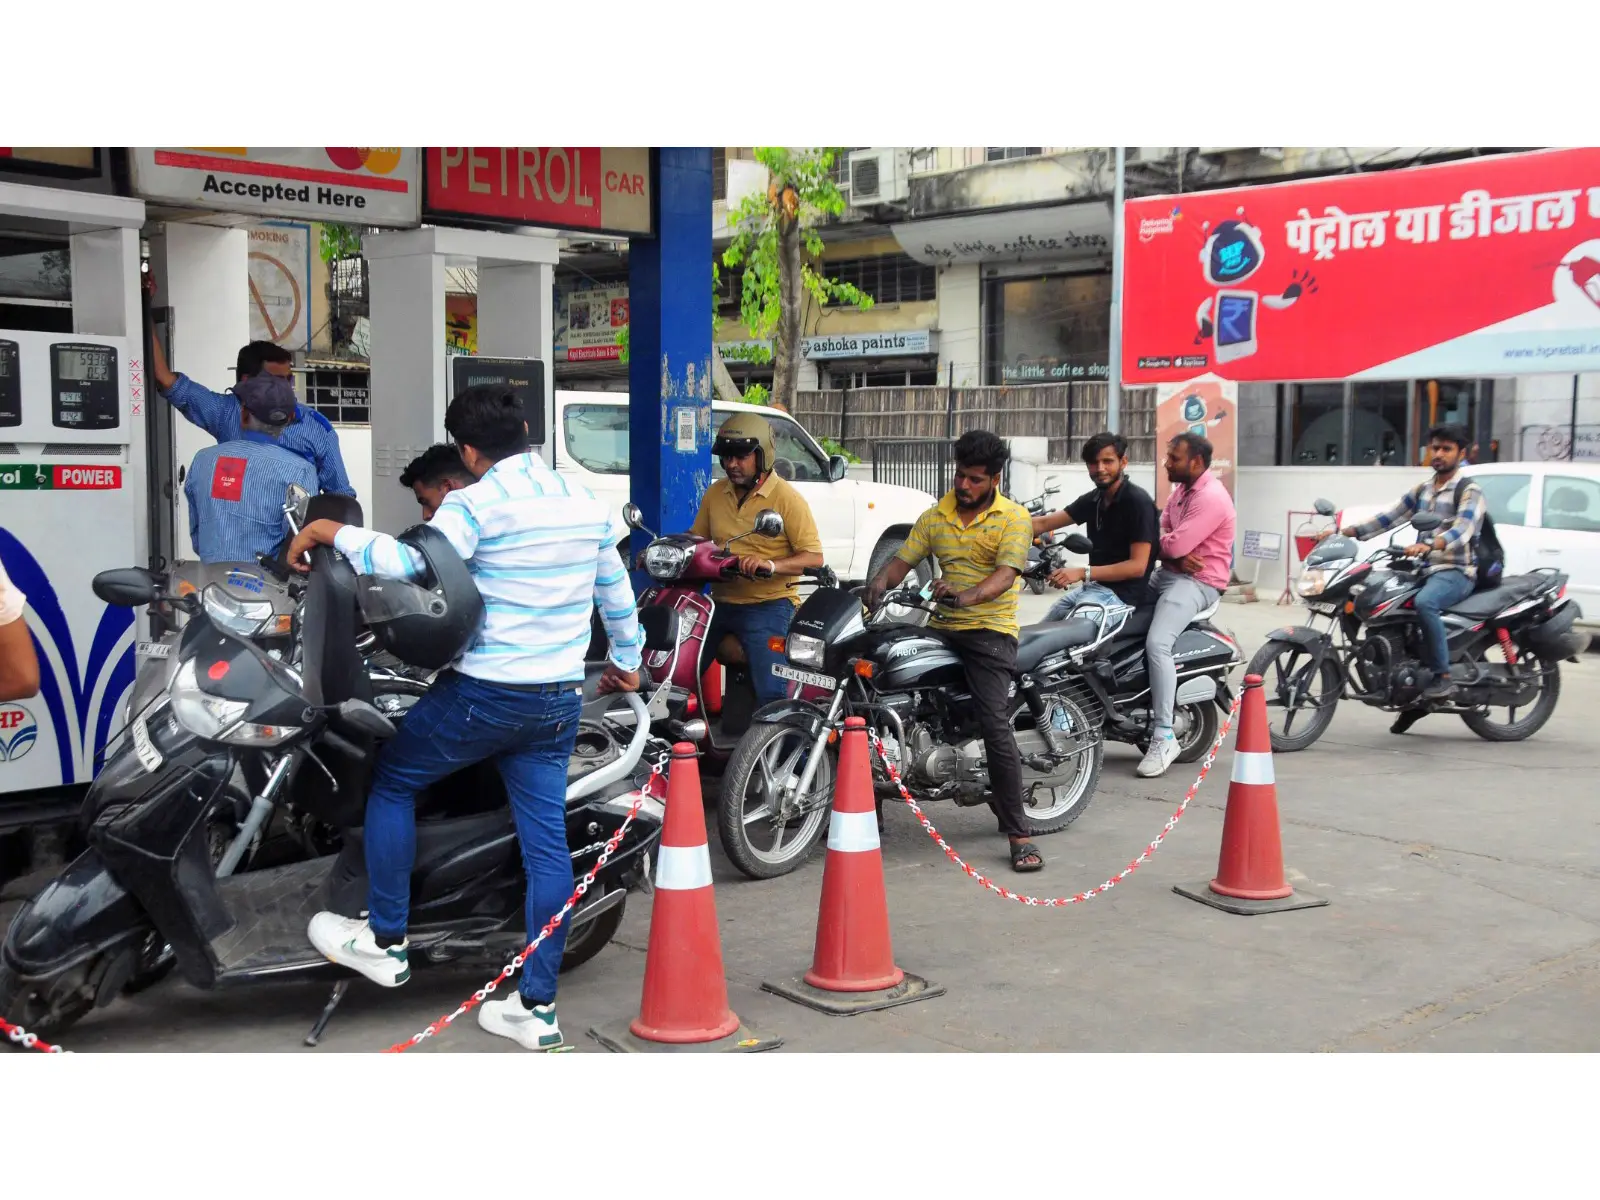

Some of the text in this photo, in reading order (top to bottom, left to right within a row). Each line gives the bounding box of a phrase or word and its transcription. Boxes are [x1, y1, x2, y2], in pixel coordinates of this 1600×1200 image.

[441, 147, 593, 207] PETROL
[604, 170, 645, 196] CAR
[203, 174, 366, 209] Accepted Here
[1284, 205, 1391, 261] पेट्रोल
[1394, 204, 1445, 244] या
[1448, 188, 1582, 241] डीजल
[248, 231, 289, 244] MOKING
[446, 345, 470, 356] EWALT
[813, 332, 906, 354] ashoka paints
[1002, 365, 1018, 377] the
[1021, 364, 1046, 377] little
[508, 378, 529, 386] Rupees
[0, 469, 20, 484] ol
[61, 468, 115, 486] POWER
[896, 647, 918, 658] Hero
